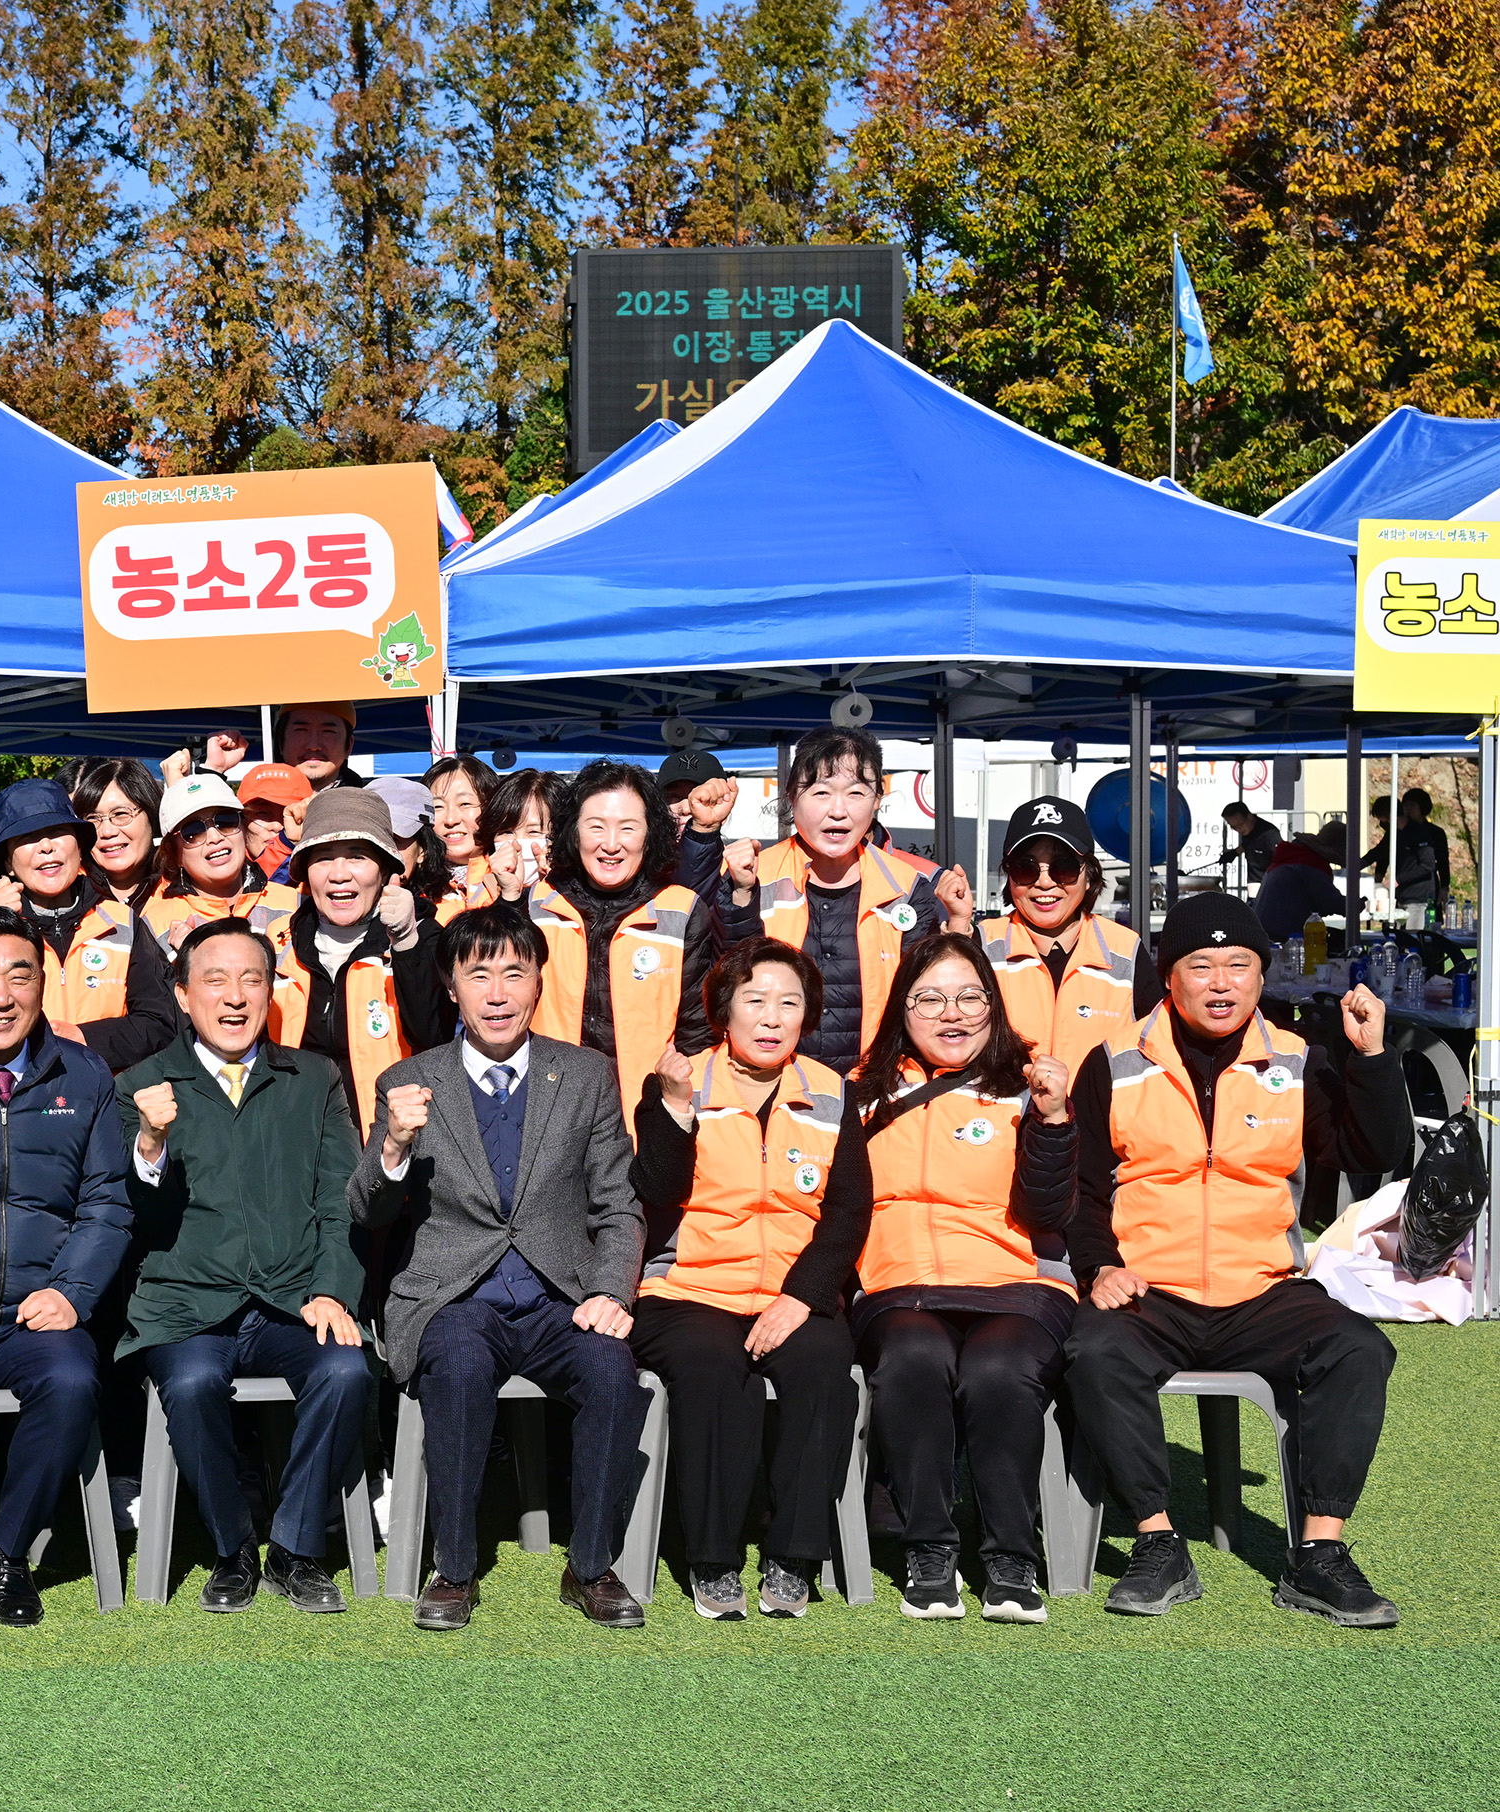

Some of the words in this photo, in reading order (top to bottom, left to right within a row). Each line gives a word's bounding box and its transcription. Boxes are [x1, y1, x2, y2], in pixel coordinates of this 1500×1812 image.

[616, 290, 690, 316] 2025
[703, 284, 862, 320] 울산광역시
[104, 491, 138, 506] 새희망
[186, 486, 236, 502] 명품북구
[1378, 529, 1406, 540] 새희망
[112, 532, 372, 619] 농소2동
[1380, 571, 1499, 637] 농소
